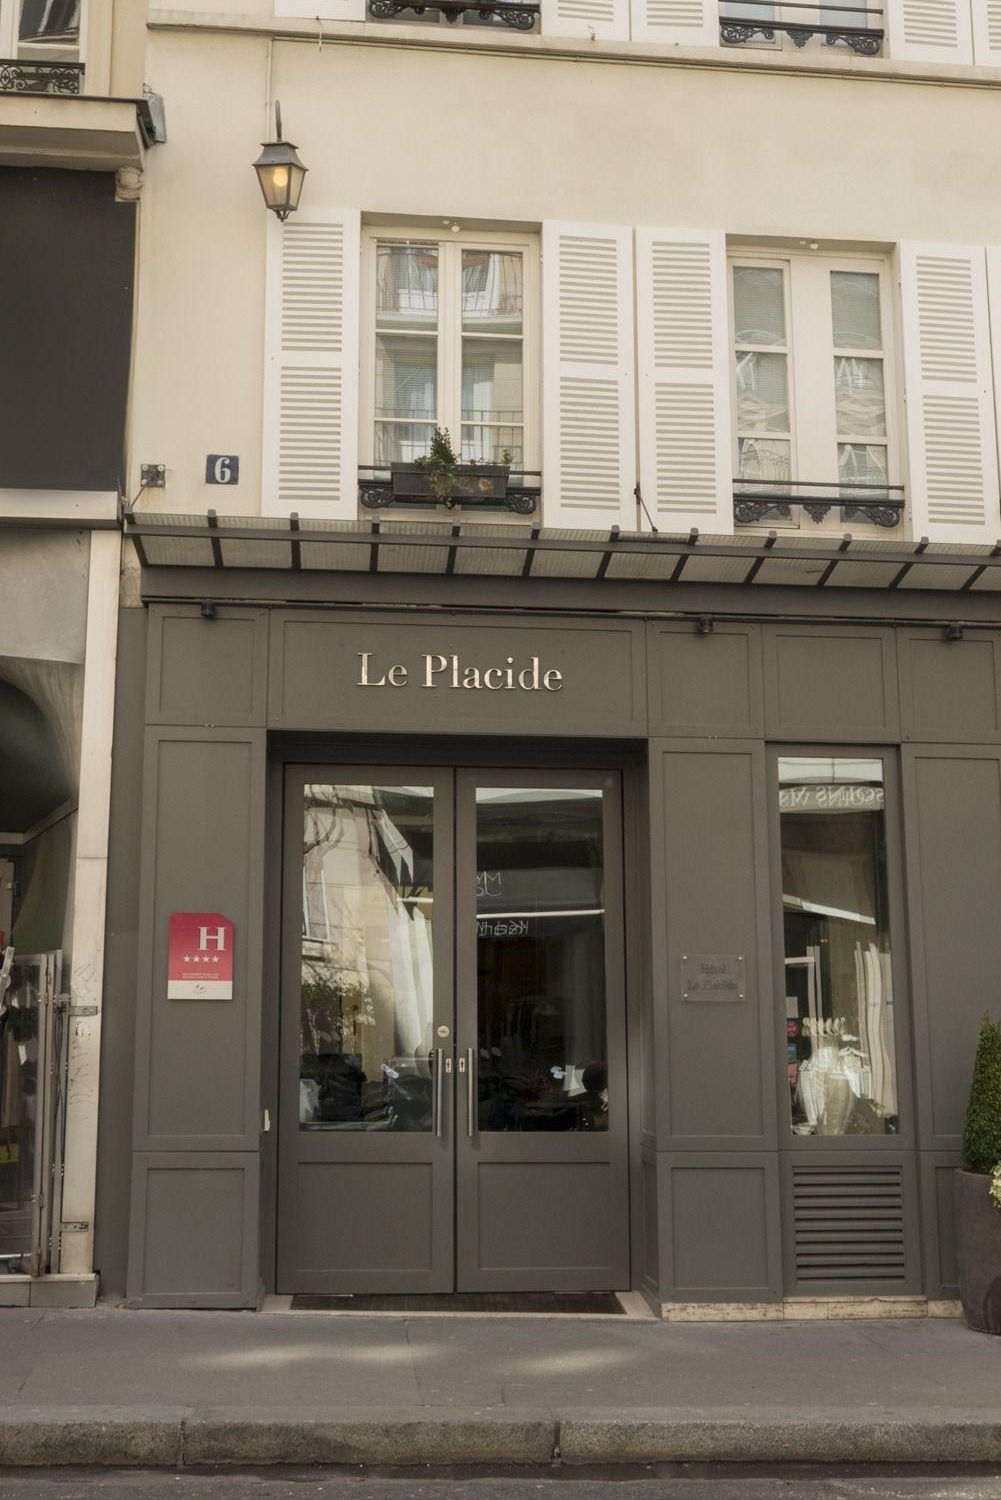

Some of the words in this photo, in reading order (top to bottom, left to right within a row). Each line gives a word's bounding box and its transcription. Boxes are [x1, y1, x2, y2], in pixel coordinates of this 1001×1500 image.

[214, 456, 231, 483] 6
[356, 652, 408, 687] Le
[421, 654, 563, 691] Placide
[197, 926, 227, 951] H
